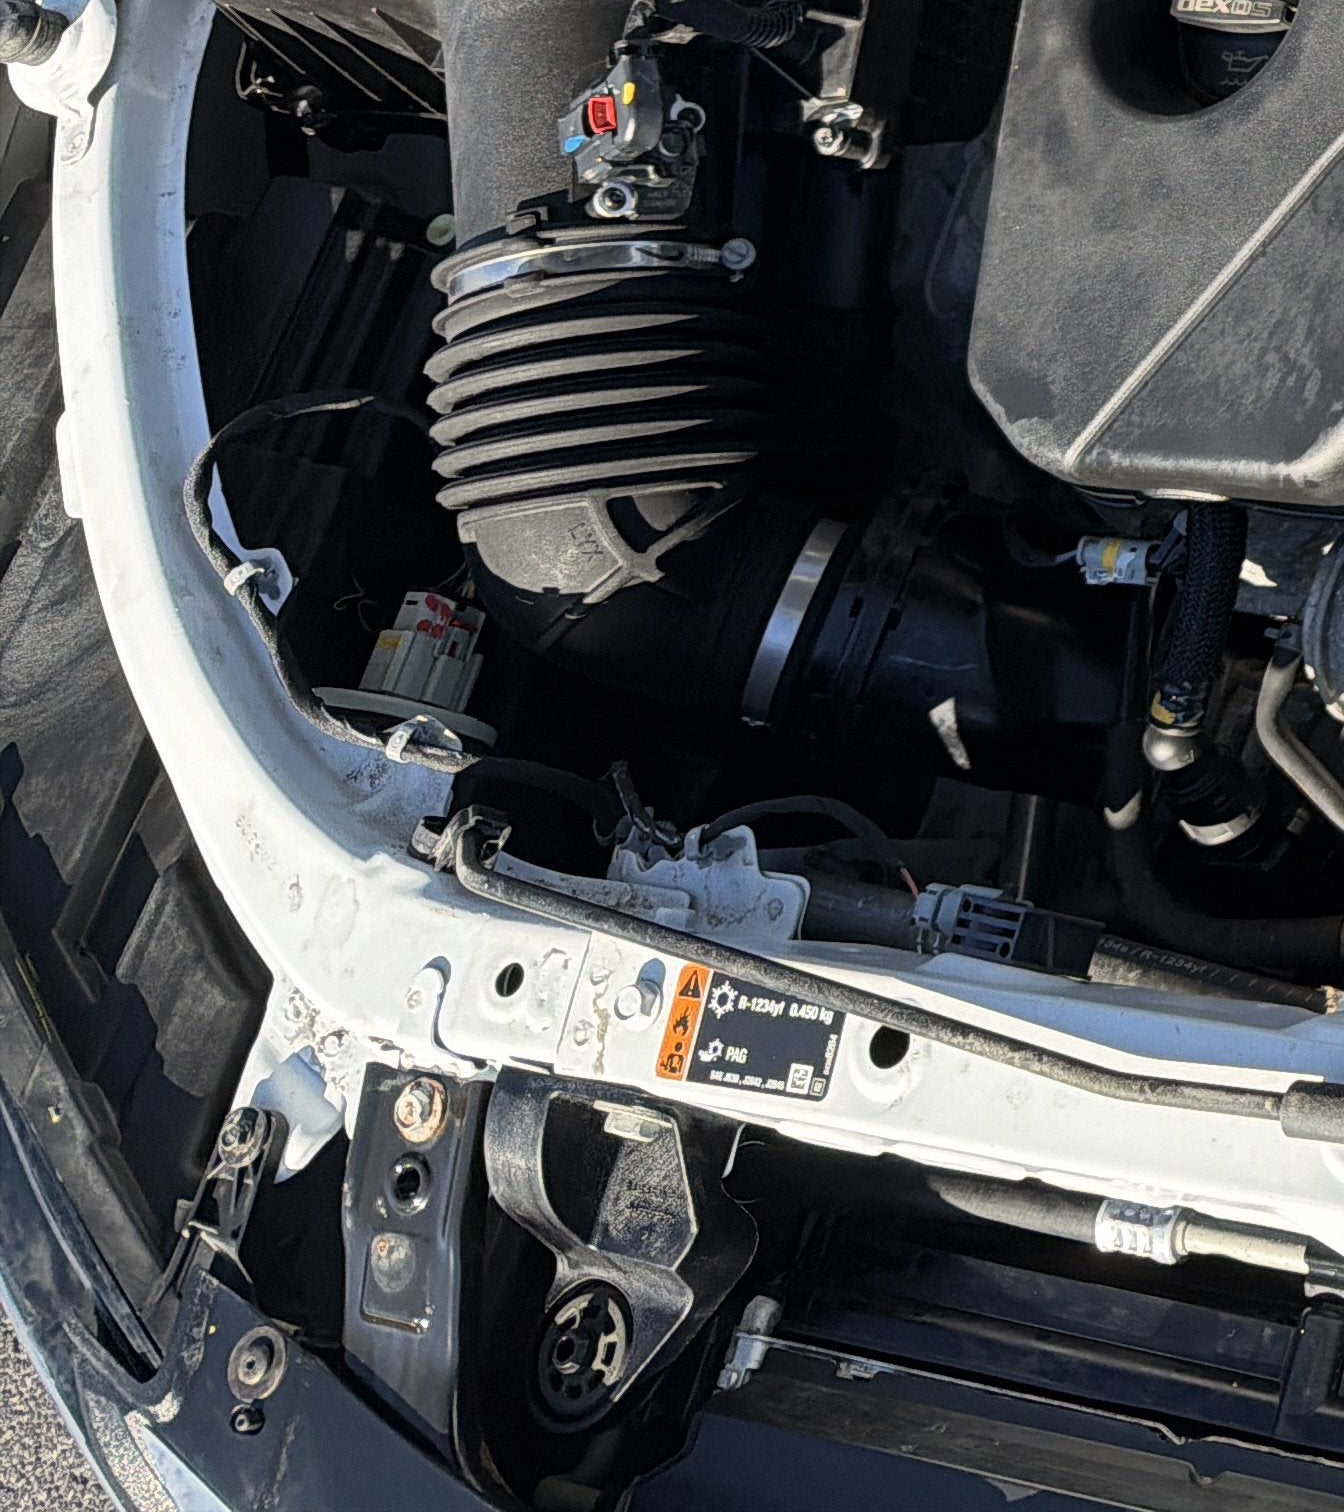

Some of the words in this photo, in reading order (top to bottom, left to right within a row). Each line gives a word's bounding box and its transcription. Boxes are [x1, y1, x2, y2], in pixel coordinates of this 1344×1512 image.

[737, 995, 786, 1017] R-1234yf
[789, 1003, 819, 1020] 0.450
[819, 1007, 834, 1025] kg
[725, 1046, 749, 1064] PAG
